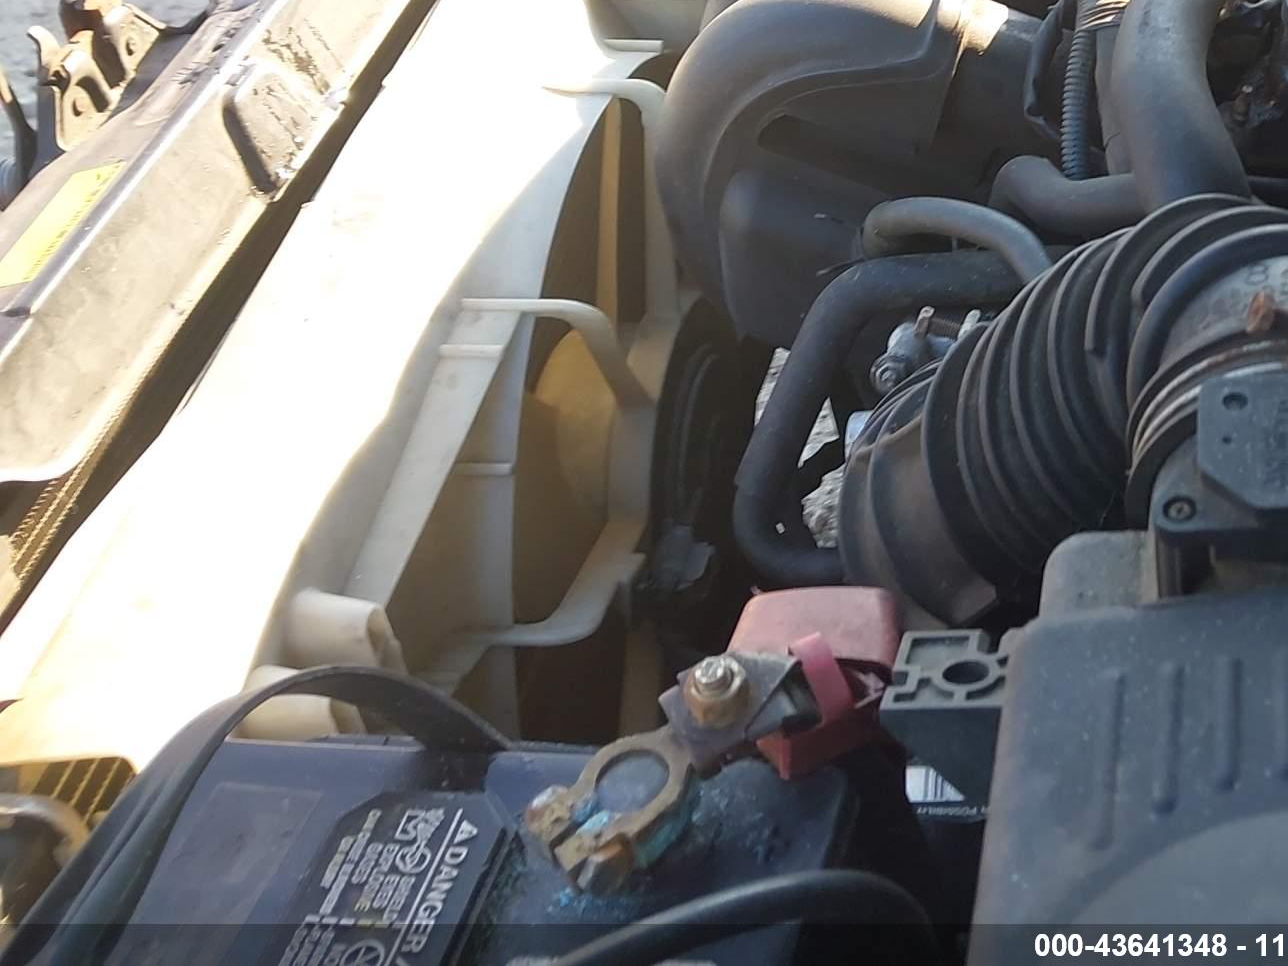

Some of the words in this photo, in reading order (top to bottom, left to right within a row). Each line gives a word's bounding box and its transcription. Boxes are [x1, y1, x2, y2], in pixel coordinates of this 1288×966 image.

[351, 842, 383, 884] GASES
[354, 843, 400, 912] EXPLOSIVE
[373, 875, 400, 909] EYES
[402, 846, 469, 953] DANGER
